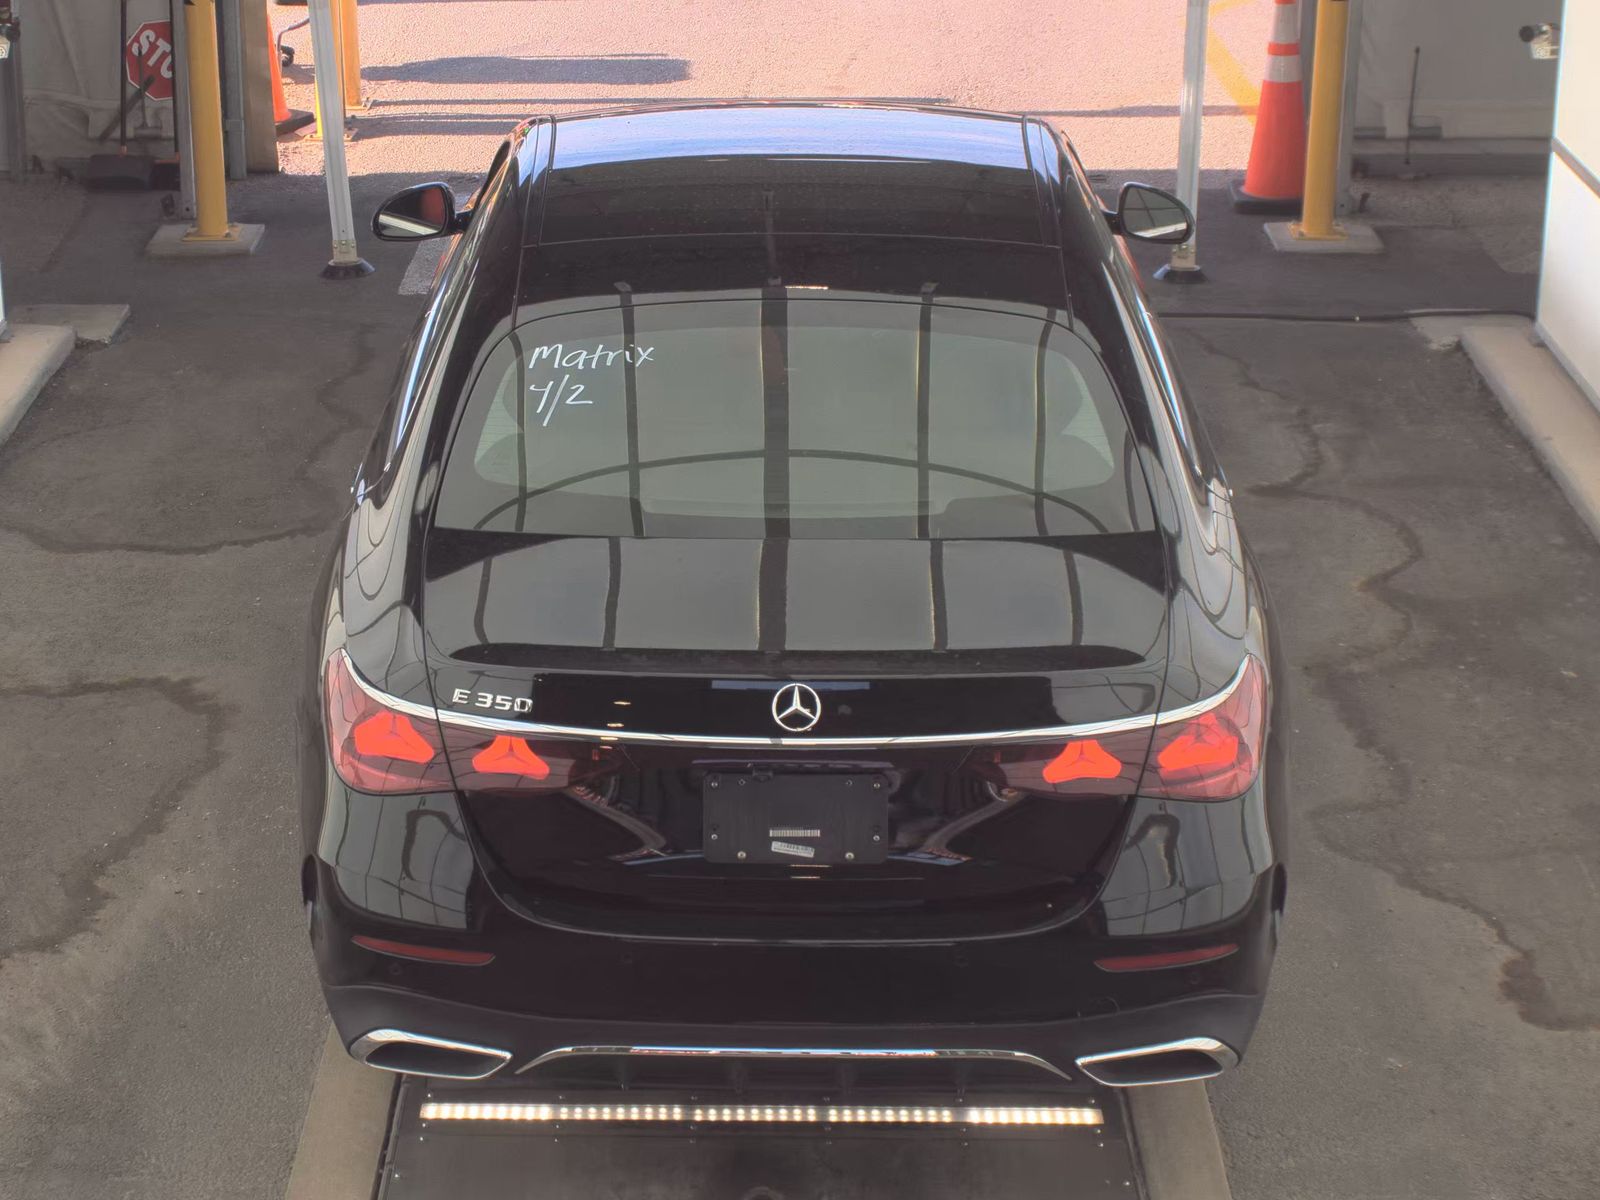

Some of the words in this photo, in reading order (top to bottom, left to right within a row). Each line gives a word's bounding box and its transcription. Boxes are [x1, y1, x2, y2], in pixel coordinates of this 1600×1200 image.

[528, 343, 655, 370] Matrix
[452, 687, 472, 704] E
[474, 691, 534, 713] 350
